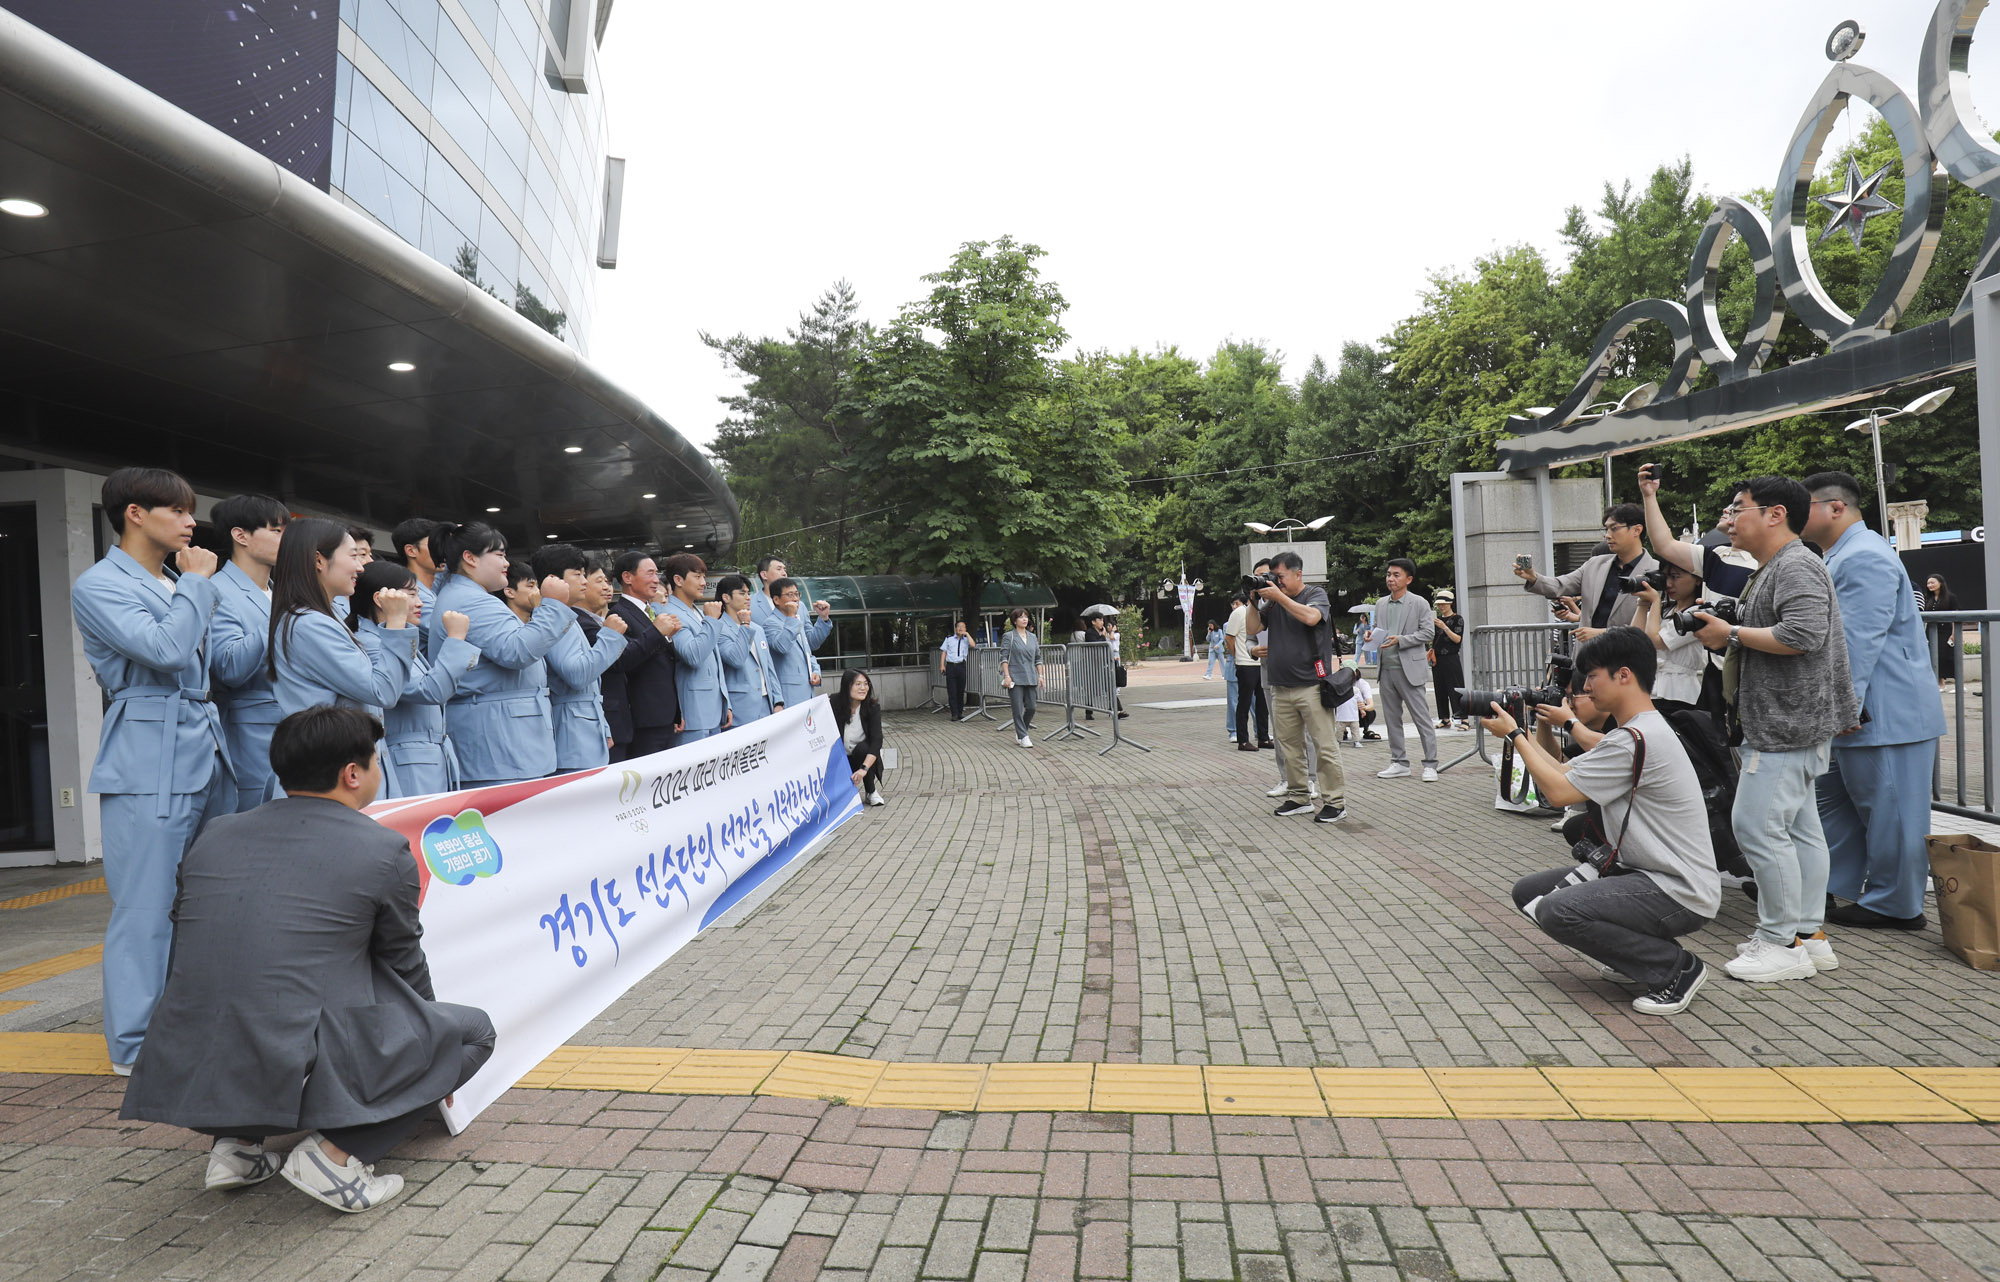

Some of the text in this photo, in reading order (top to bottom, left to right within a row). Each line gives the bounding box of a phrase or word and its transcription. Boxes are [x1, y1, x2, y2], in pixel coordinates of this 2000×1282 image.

[651, 738, 769, 809] 2024 파리 하계올림픽
[615, 805, 647, 822] PARIS 2024
[433, 831, 485, 857] 변화의 중심
[442, 846, 493, 875] 기회의 경기
[539, 766, 831, 969] 경기도 선수단의 선전을 기원합니다
